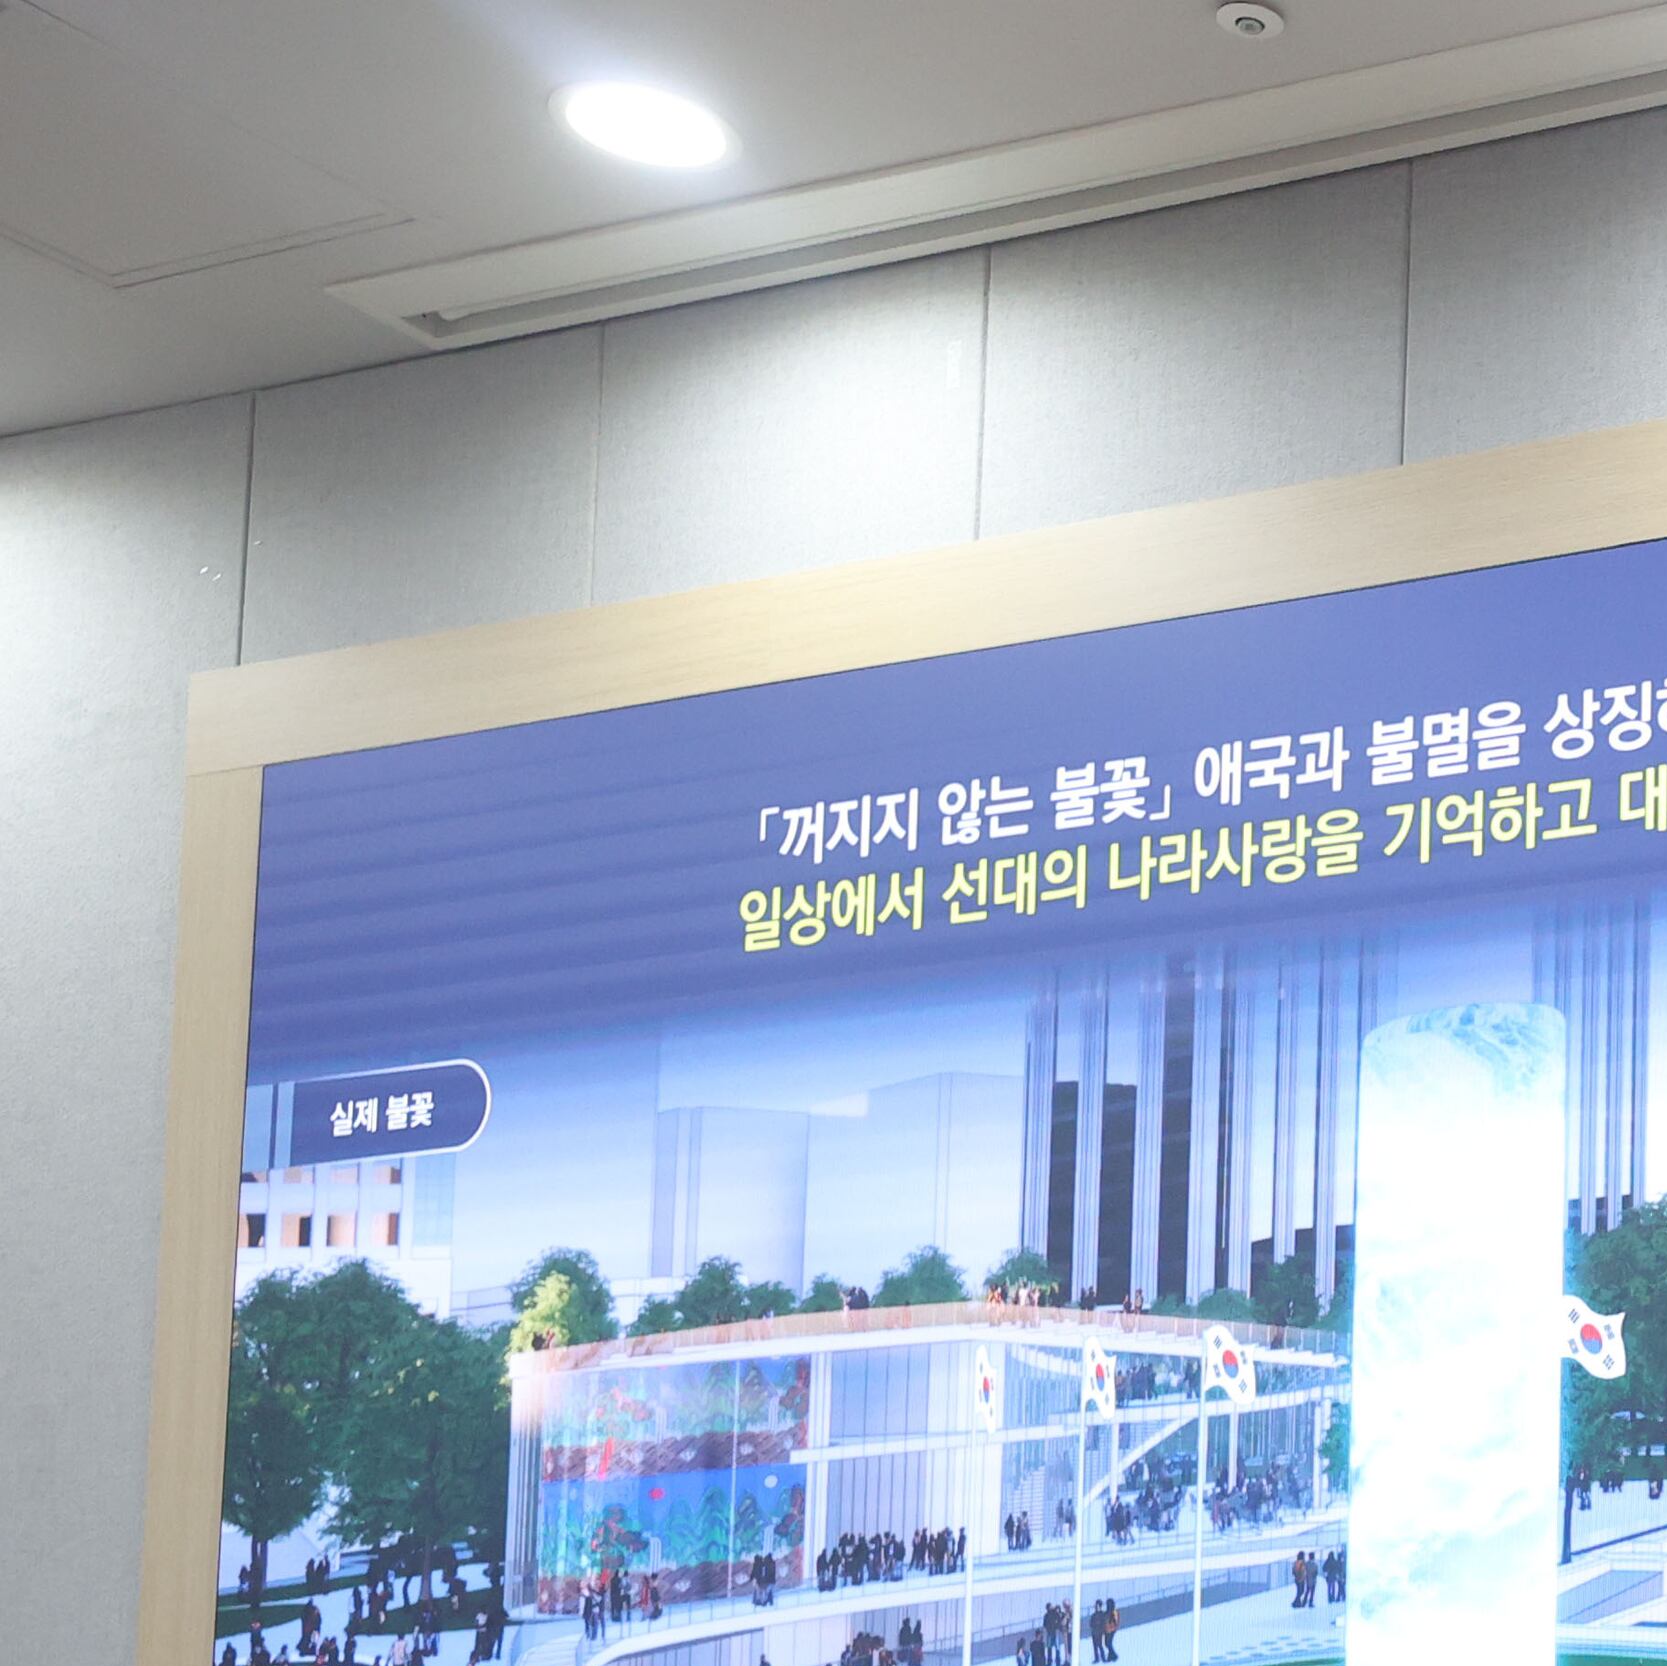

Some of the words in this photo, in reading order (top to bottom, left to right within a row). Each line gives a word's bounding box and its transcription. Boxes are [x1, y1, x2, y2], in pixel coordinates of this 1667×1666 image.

[758, 785, 920, 865] 「꺼지지
[937, 780, 1035, 846] 않는
[1049, 756, 1172, 828] 불꽃」
[1194, 726, 1348, 807] 애국과
[1366, 699, 1527, 786] 불멸을
[738, 867, 924, 953] 일상에서
[941, 844, 1087, 925] 선대의
[1108, 808, 1365, 901] 나라사랑을
[1382, 778, 1598, 864] 기억하고
[329, 1096, 379, 1138] 실제
[385, 1090, 435, 1130] 불꽃
